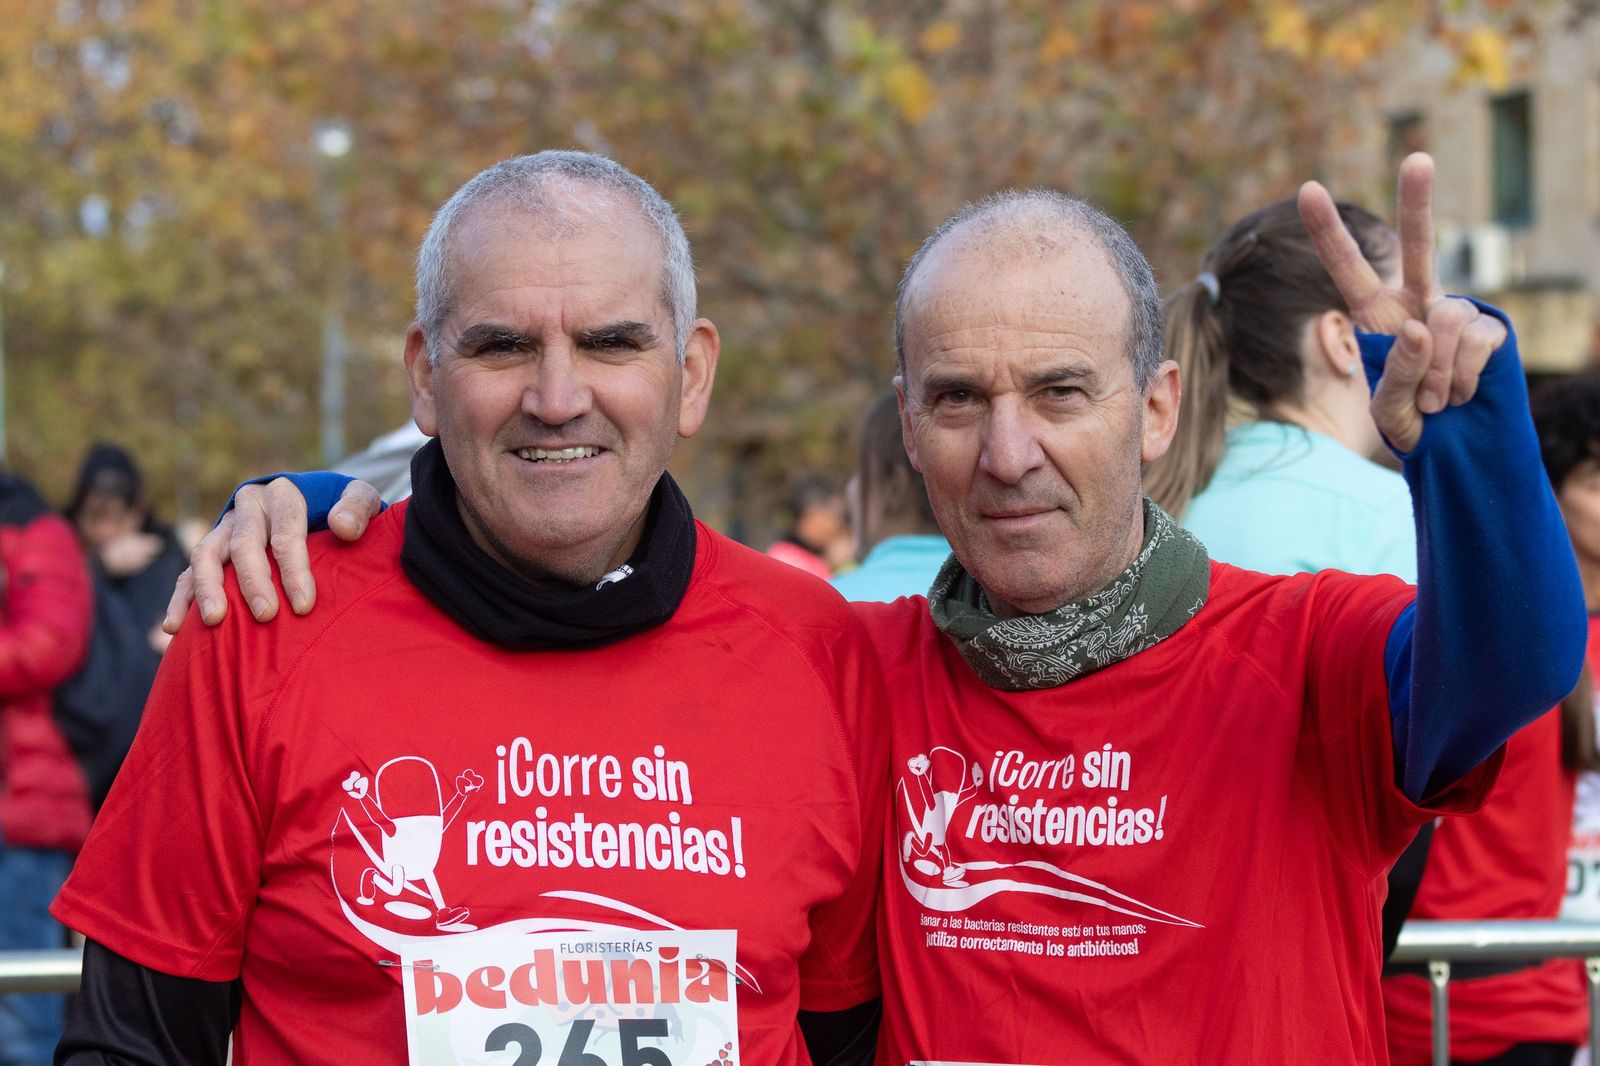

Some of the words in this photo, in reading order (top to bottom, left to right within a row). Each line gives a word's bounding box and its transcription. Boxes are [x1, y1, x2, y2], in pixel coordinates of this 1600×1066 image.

[495, 736, 622, 805] ¡Corre
[632, 744, 693, 805] sin
[989, 750, 1075, 793] ¡Corre
[1081, 743, 1131, 791] sin
[466, 806, 746, 879] resistencias!
[965, 794, 1168, 846] resistencias!
[560, 938, 653, 954] FLORISTERÍAS
[925, 931, 958, 949] ¡utiliza
[960, 936, 1044, 956] correctamente
[1046, 939, 1065, 957] los
[1067, 938, 1139, 957] antibióticos!
[942, 918, 948, 928] a
[949, 915, 962, 930] las
[964, 917, 1006, 932] bacterias
[1007, 921, 1060, 937] resistentes
[1061, 924, 1081, 937] está
[1082, 926, 1094, 937] en
[1095, 924, 1111, 936] tus
[1112, 923, 1147, 936] manos:
[412, 946, 729, 1017] bedunia
[484, 1018, 671, 1066] 265
